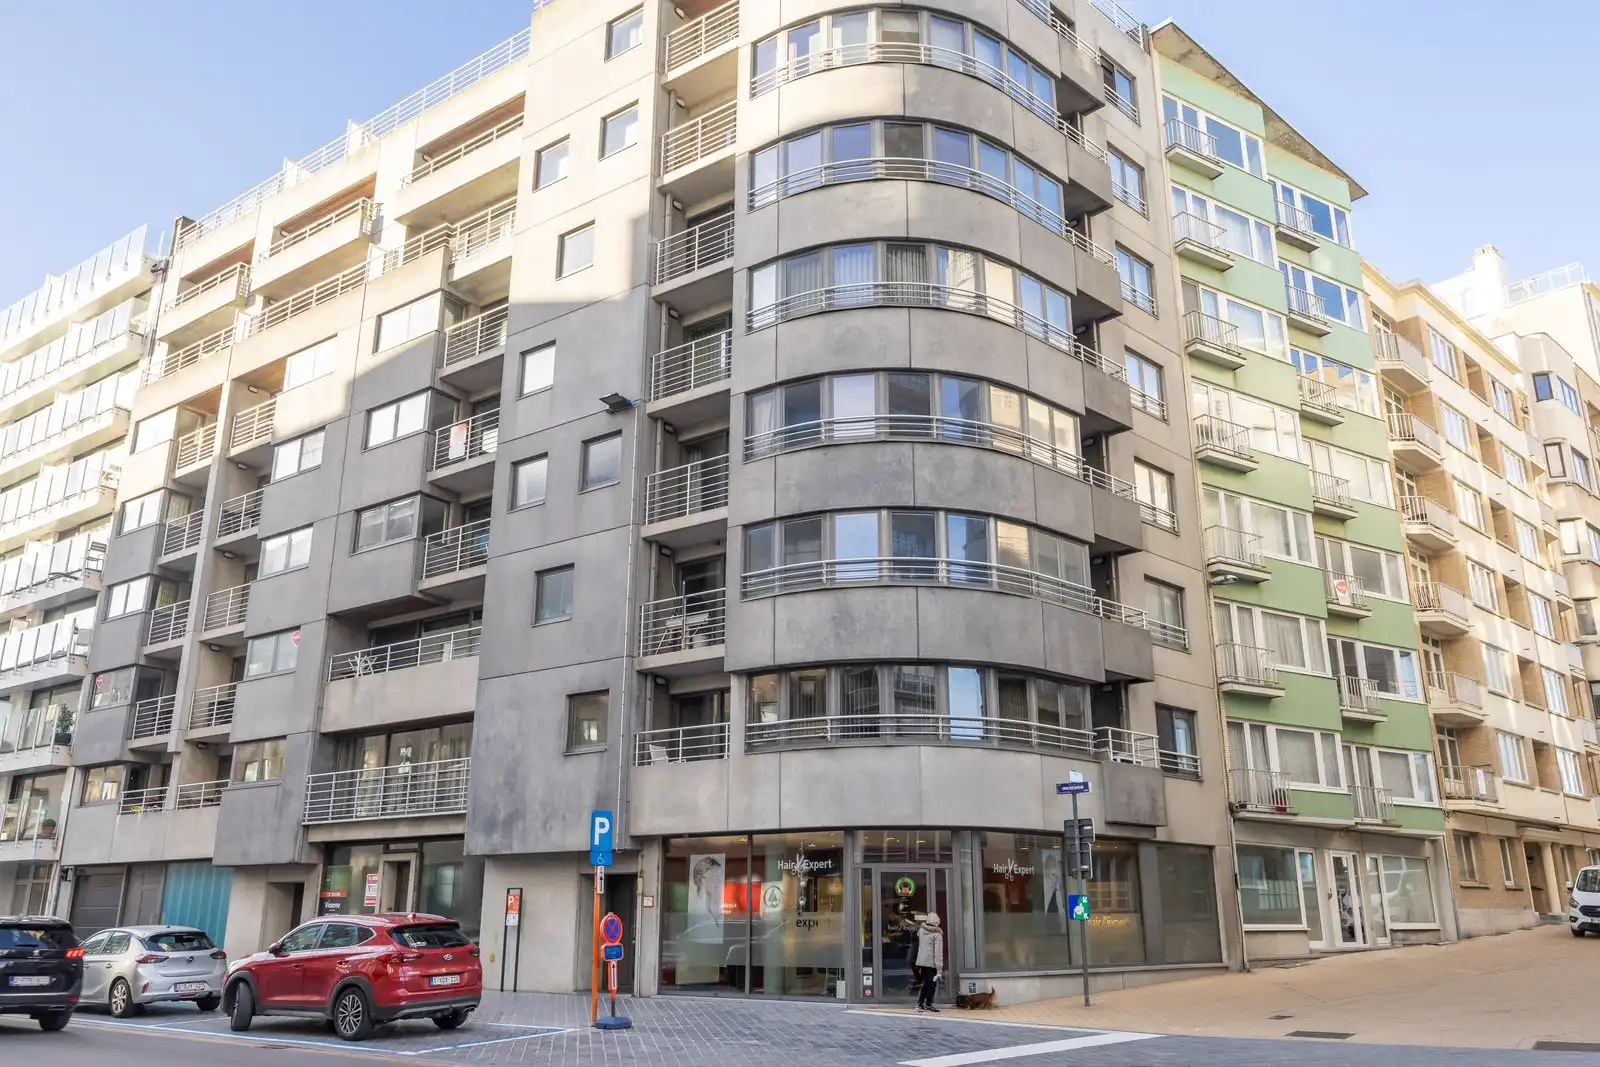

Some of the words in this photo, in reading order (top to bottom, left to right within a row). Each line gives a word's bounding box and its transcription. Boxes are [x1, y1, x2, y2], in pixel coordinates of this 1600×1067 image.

[594, 817, 610, 846] P
[777, 860, 796, 870] Hair
[803, 859, 833, 872] Expert
[993, 863, 1008, 874] Hair
[1013, 864, 1036, 877] Expert
[508, 895, 515, 906] P
